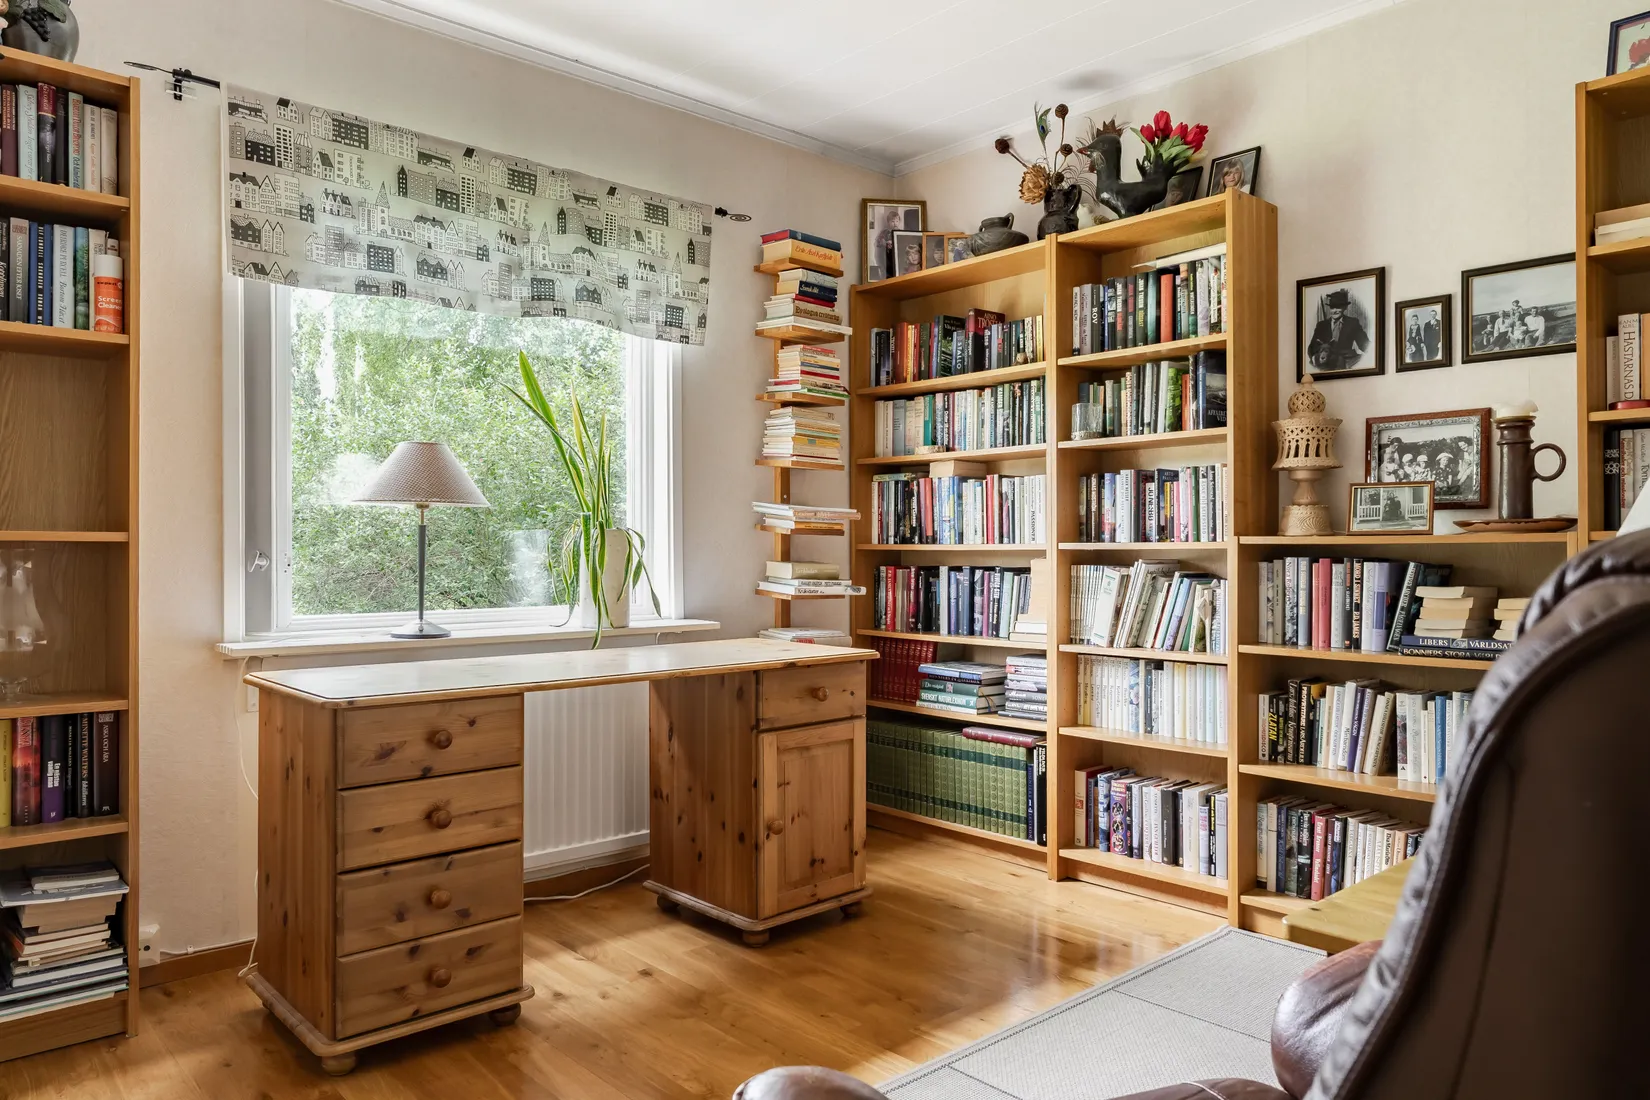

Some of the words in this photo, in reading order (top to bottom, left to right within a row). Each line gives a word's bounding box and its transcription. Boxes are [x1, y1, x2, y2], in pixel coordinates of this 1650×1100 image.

[1419, 638, 1448, 646] LIBERS
[1403, 648, 1443, 657] BONNIERS
[1268, 712, 1277, 740] ZLATAN
